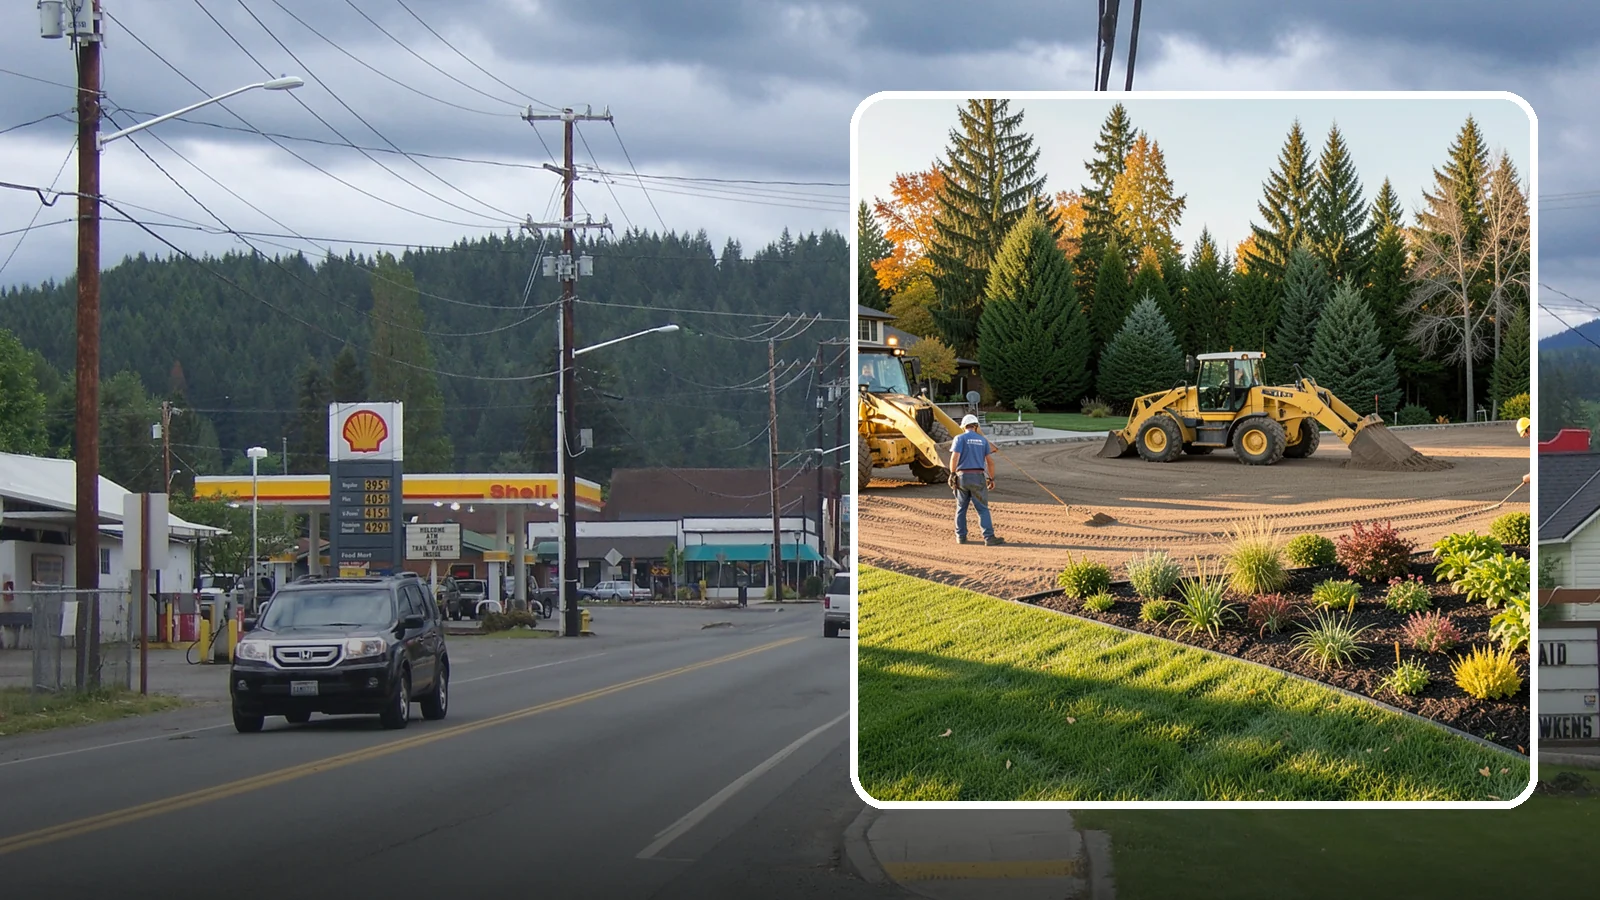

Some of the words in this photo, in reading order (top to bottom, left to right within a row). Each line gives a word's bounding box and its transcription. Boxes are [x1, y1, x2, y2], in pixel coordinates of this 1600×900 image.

[366, 480, 383, 490] 395
[490, 484, 547, 498] Shell
[366, 494, 383, 504] 405
[366, 508, 383, 518] 415
[366, 522, 383, 532] 429
